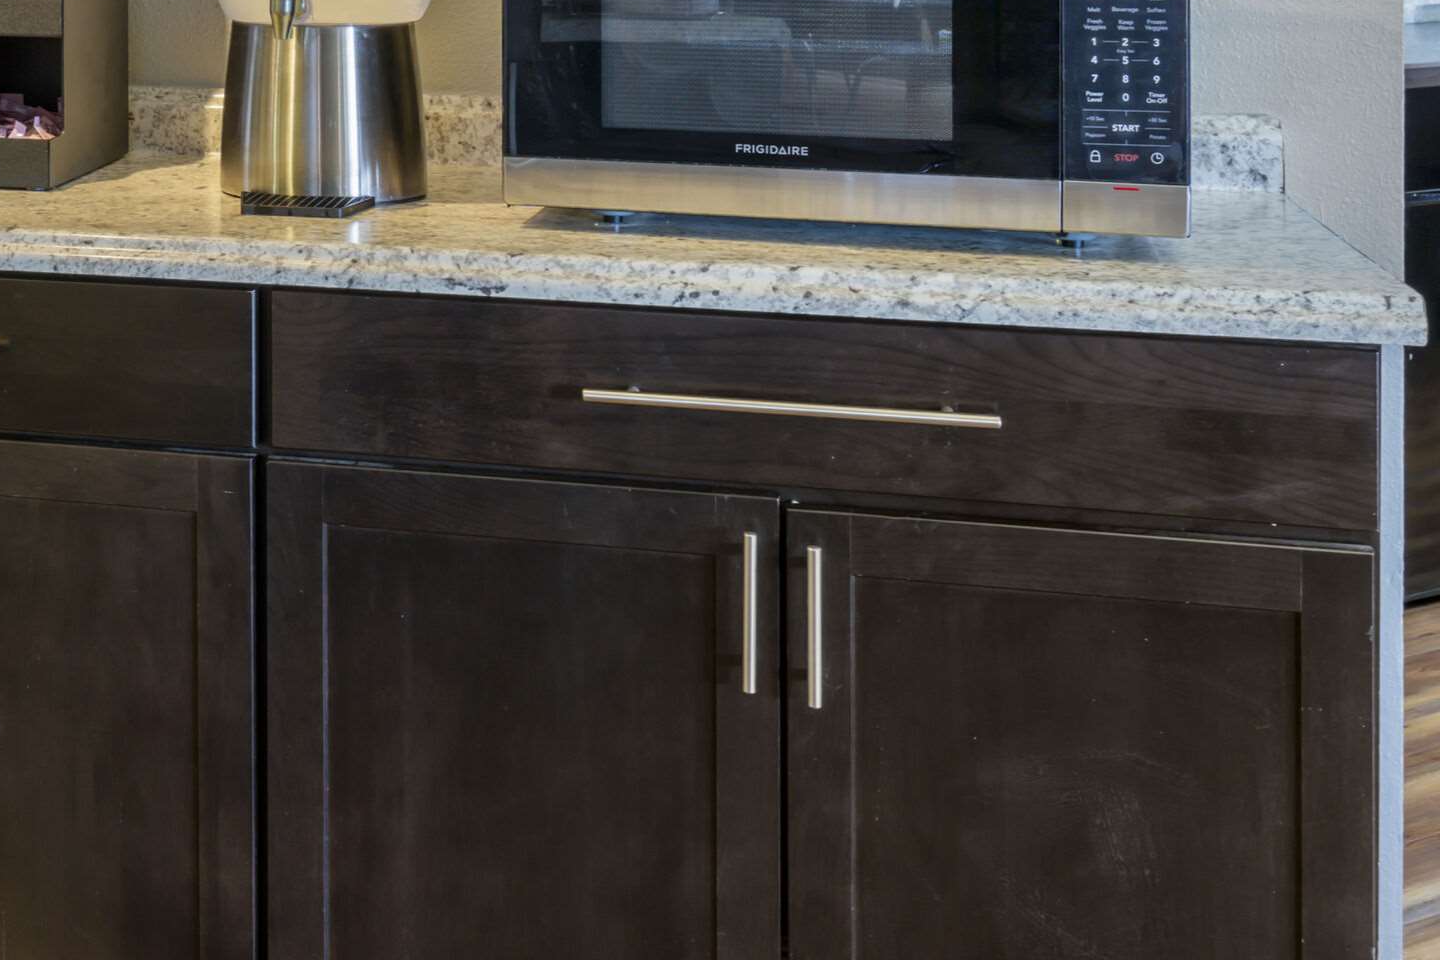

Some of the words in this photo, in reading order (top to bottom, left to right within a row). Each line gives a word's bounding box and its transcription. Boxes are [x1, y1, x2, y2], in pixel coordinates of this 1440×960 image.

[1090, 37, 1097, 46] 1
[1121, 37, 1129, 47] 2
[1152, 38, 1160, 47] 3
[1090, 55, 1098, 64] 4
[1122, 56, 1129, 65] 5
[1152, 56, 1160, 65] 6
[1091, 74, 1098, 83] 7
[1122, 74, 1129, 84] 8
[1152, 75, 1160, 84] 9
[1121, 92, 1130, 102] 0
[1111, 124, 1140, 132] START
[735, 144, 809, 156] FRIGIDAIRE
[1114, 153, 1139, 162] STOP
